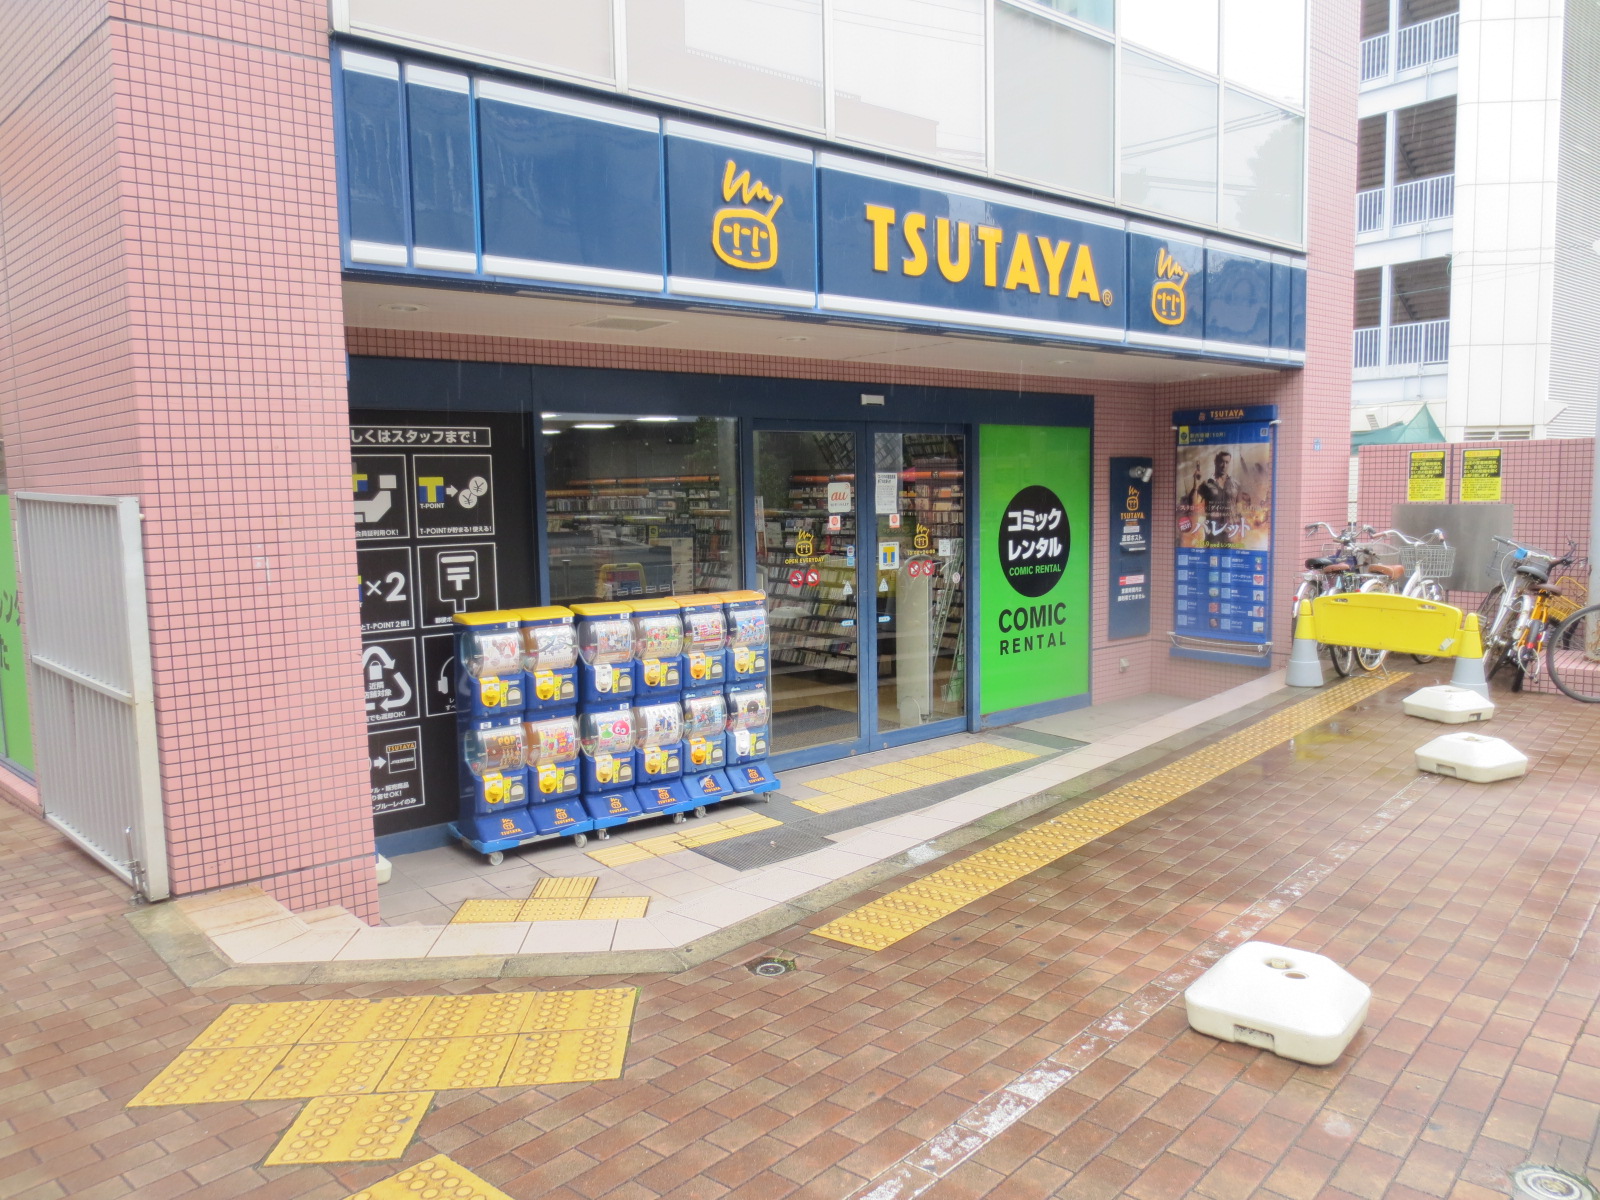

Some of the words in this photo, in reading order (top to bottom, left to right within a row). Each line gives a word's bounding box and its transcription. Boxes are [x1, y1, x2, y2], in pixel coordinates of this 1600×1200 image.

[866, 202, 1101, 303] TSUTAYA
[1210, 409, 1244, 418] TSUTAYA
[831, 491, 848, 502] au
[1007, 508, 1062, 532] コミック
[1120, 512, 1145, 520] TSUTAYA
[1191, 518, 1251, 538] バレット
[1008, 537, 1063, 561] レンタル
[799, 556, 826, 564] EVERYDAY
[1009, 565, 1034, 576] COMIC
[1035, 563, 1061, 574] RENTAL
[998, 602, 1067, 634] COMIC
[999, 631, 1067, 656] RENTAL
[387, 742, 416, 753] TSUTAYA
[703, 786, 722, 794] TSUTAYA
[657, 797, 676, 805] TSUTAYA
[554, 817, 575, 825] TSUTAYA
[500, 828, 523, 836] TSUTAYA
